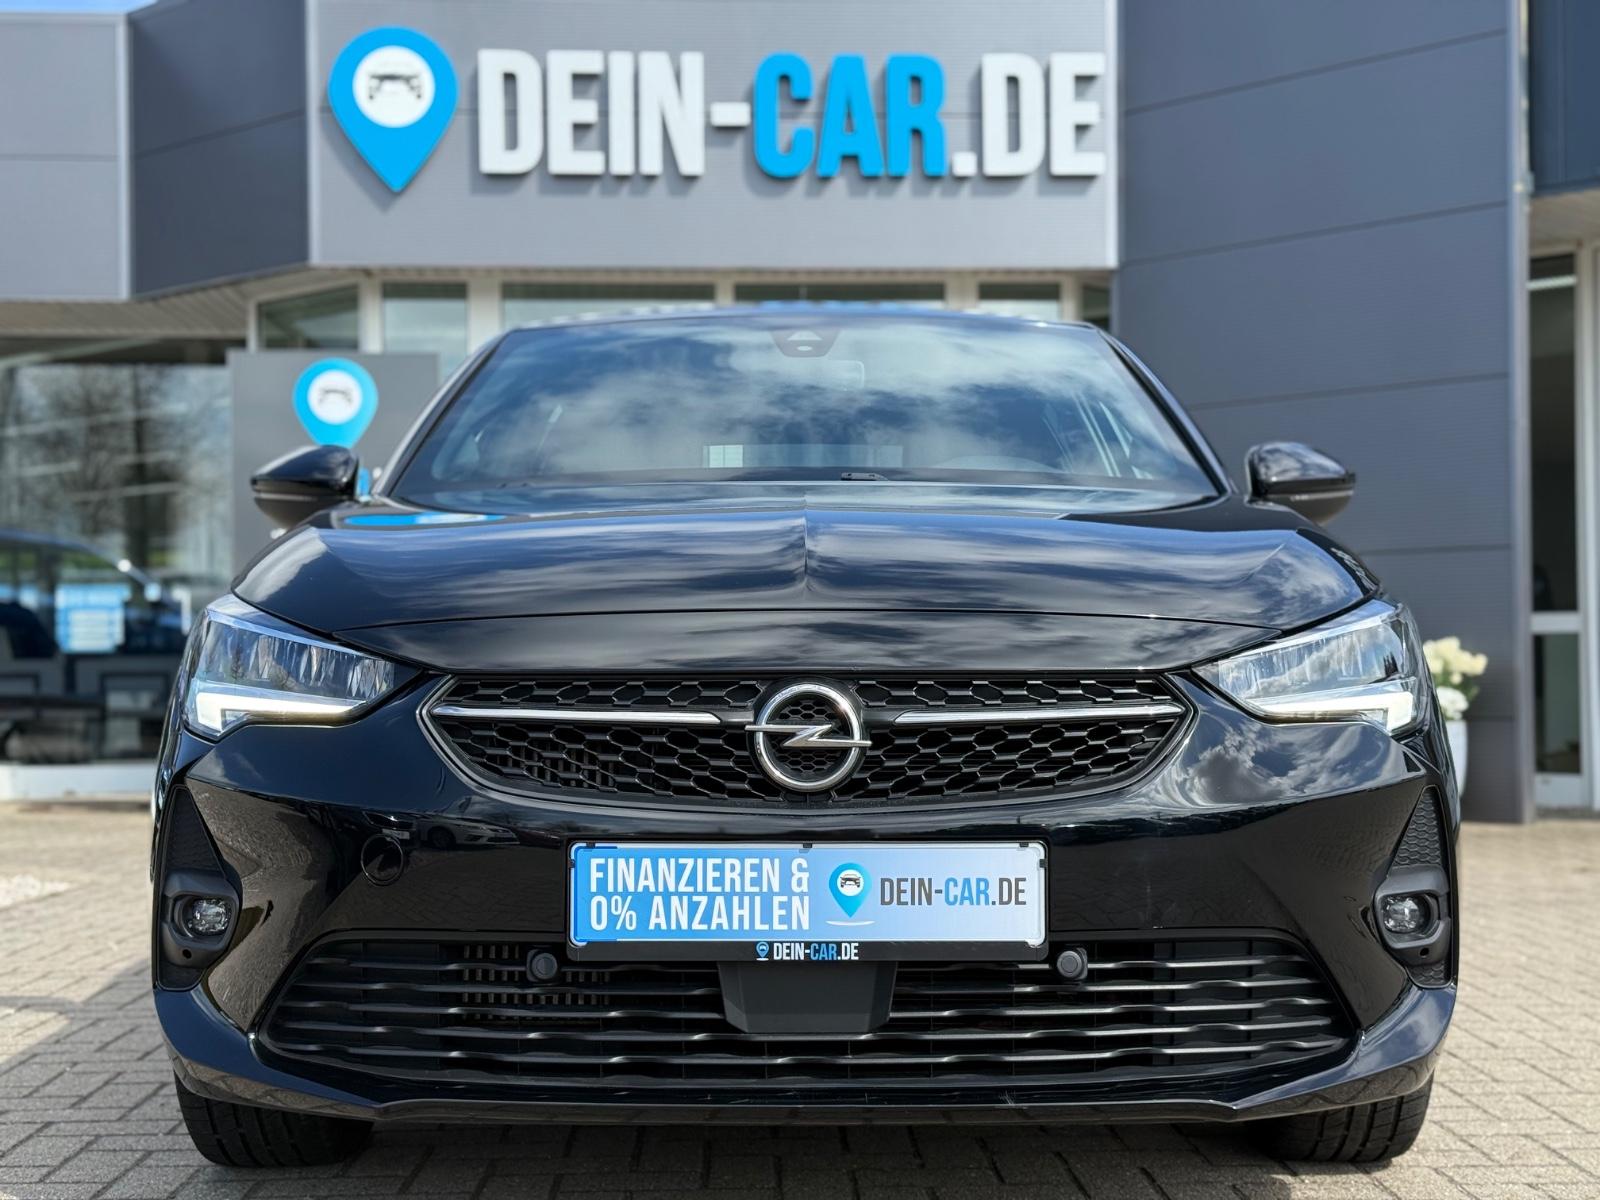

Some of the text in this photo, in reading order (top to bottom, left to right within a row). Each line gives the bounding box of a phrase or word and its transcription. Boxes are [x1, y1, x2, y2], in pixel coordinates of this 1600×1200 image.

[477, 49, 1106, 179] DEIN-CAR.DE
[590, 857, 810, 893] FINANZIEREN &
[880, 877, 1027, 906] DEIN-CAR.DE
[590, 896, 810, 931] 0% ANZAHLEN
[773, 942, 860, 961] DEIN-CAR.DE
